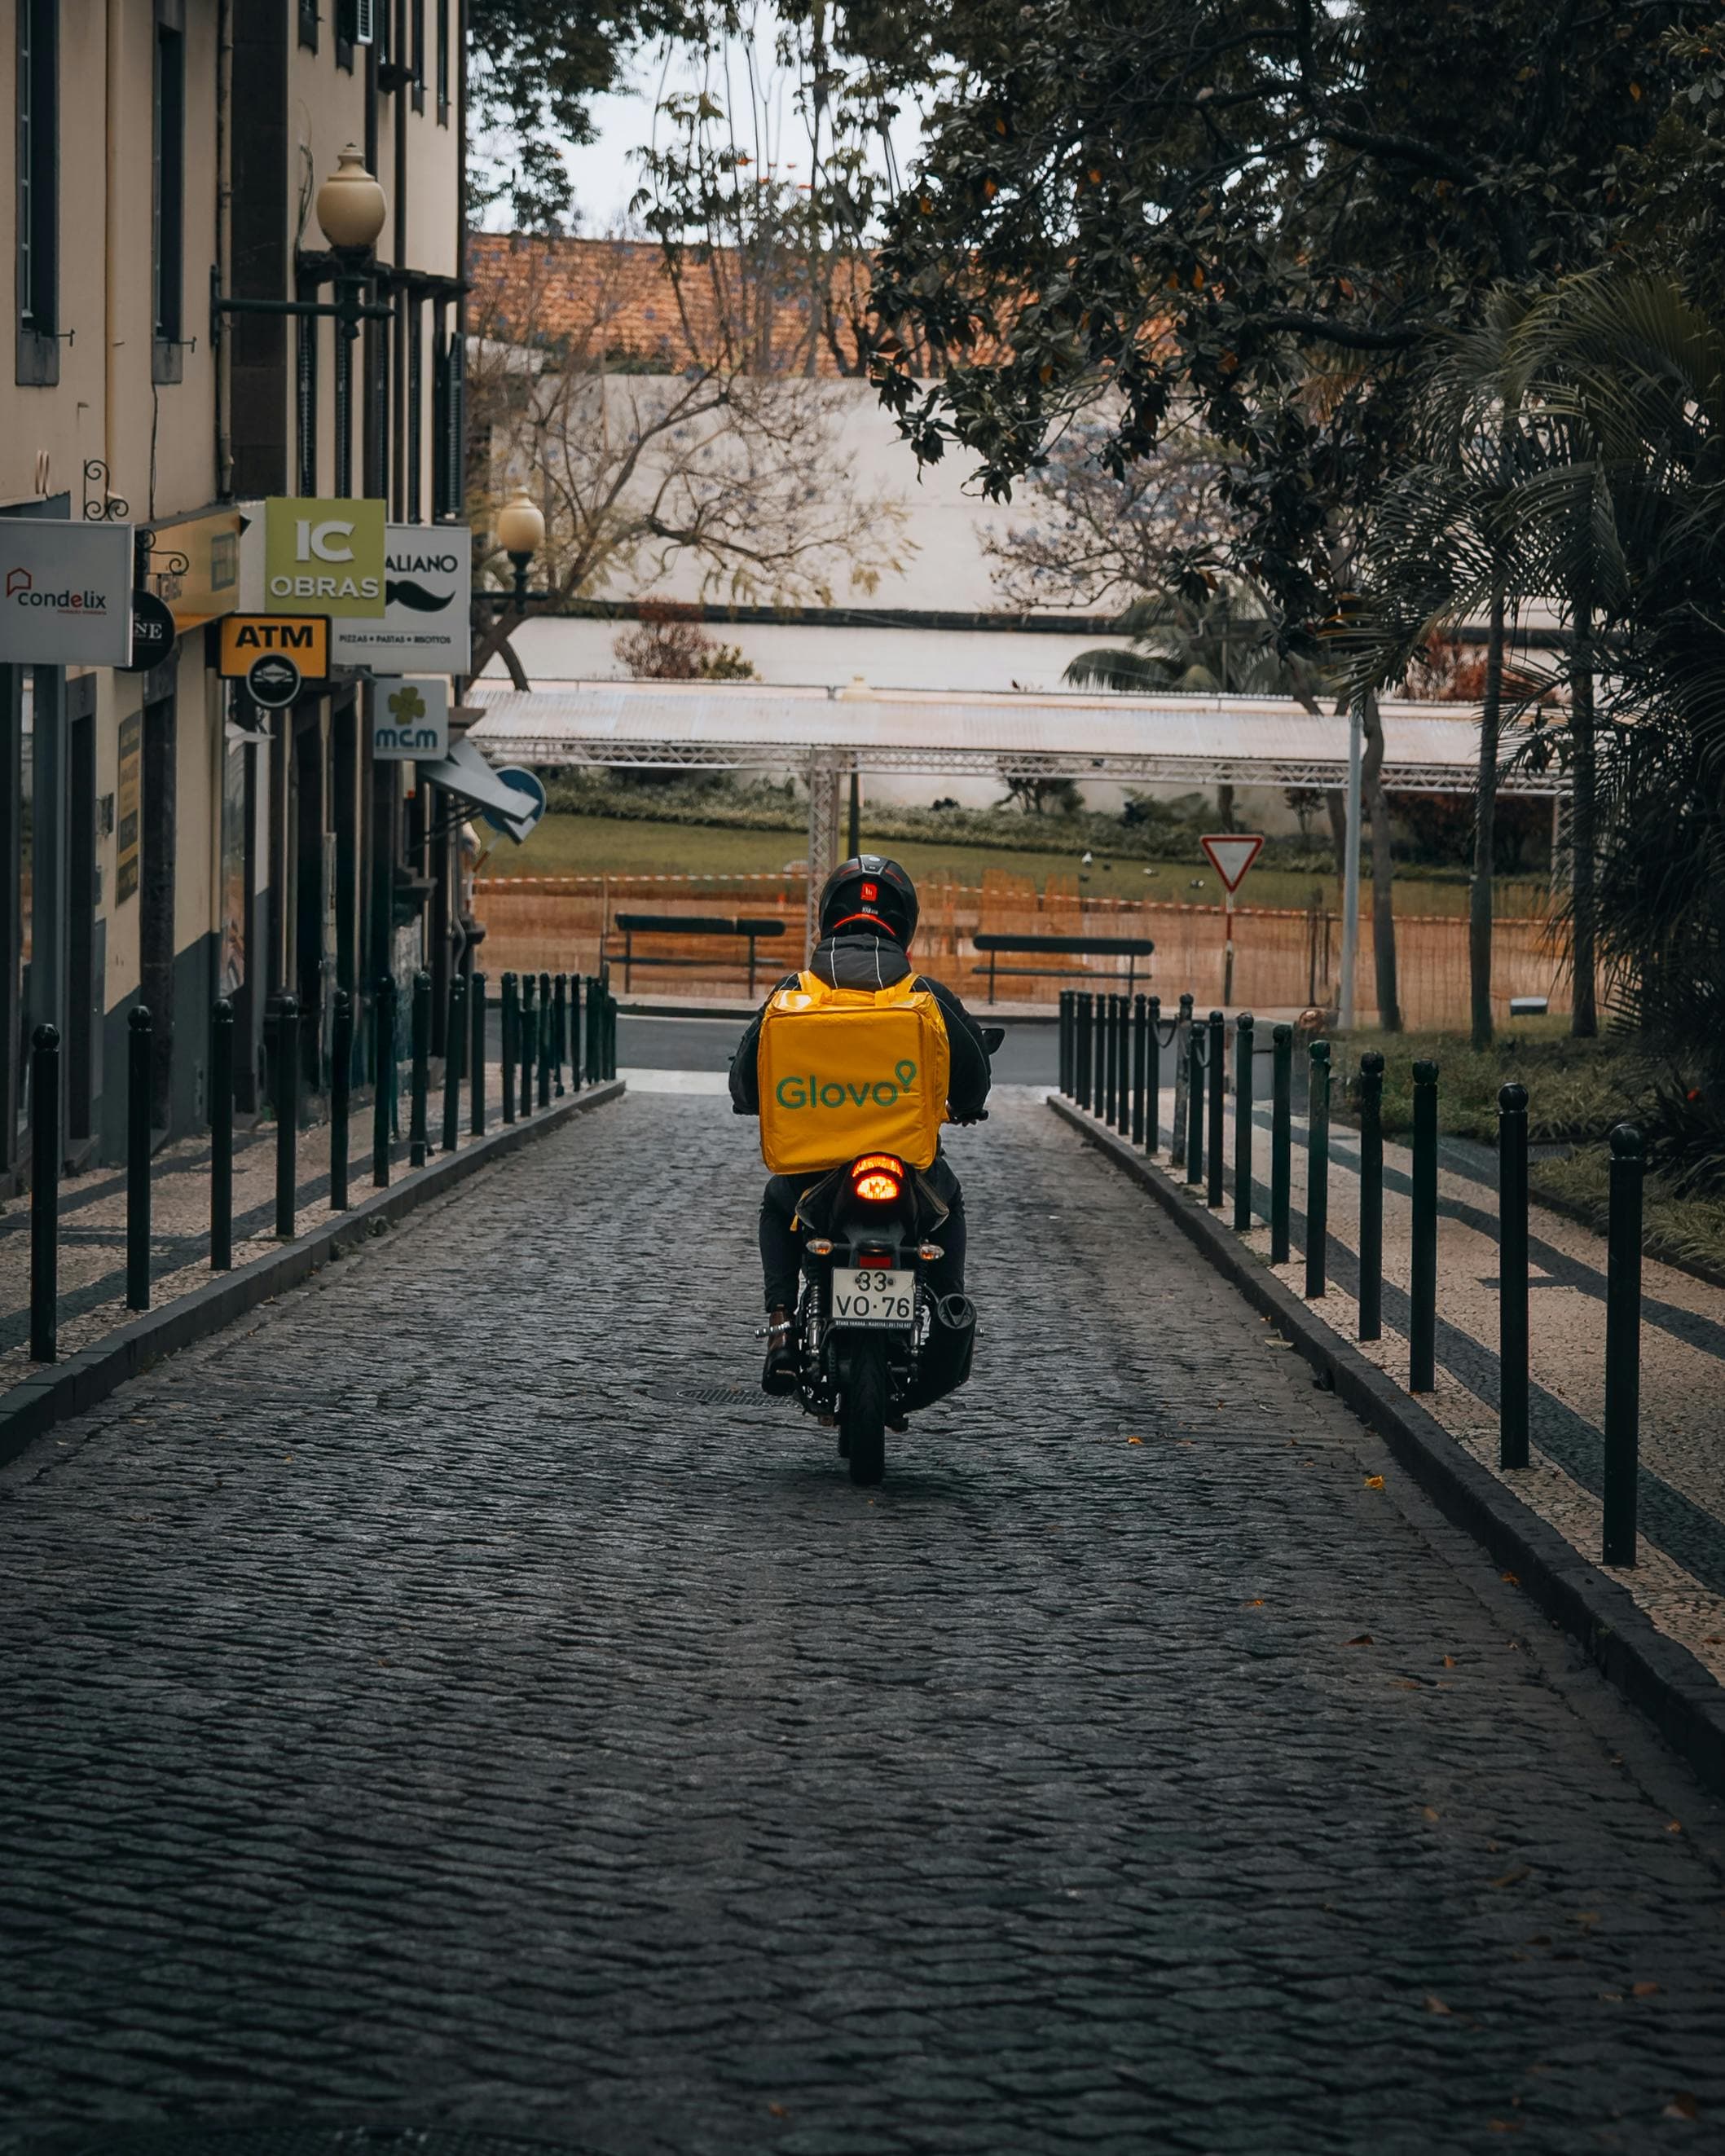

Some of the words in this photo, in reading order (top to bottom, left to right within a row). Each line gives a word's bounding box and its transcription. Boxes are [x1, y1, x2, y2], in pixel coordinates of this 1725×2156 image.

[295, 520, 355, 562] IC
[271, 576, 379, 599] OBRAS
[18, 590, 106, 609] condelix
[235, 626, 313, 648] ATM
[339, 635, 367, 644] PIZZAS
[376, 635, 405, 644] PASTAS
[376, 728, 438, 748] mcm
[777, 1075, 898, 1109] Glovo
[857, 1271, 887, 1292] 33
